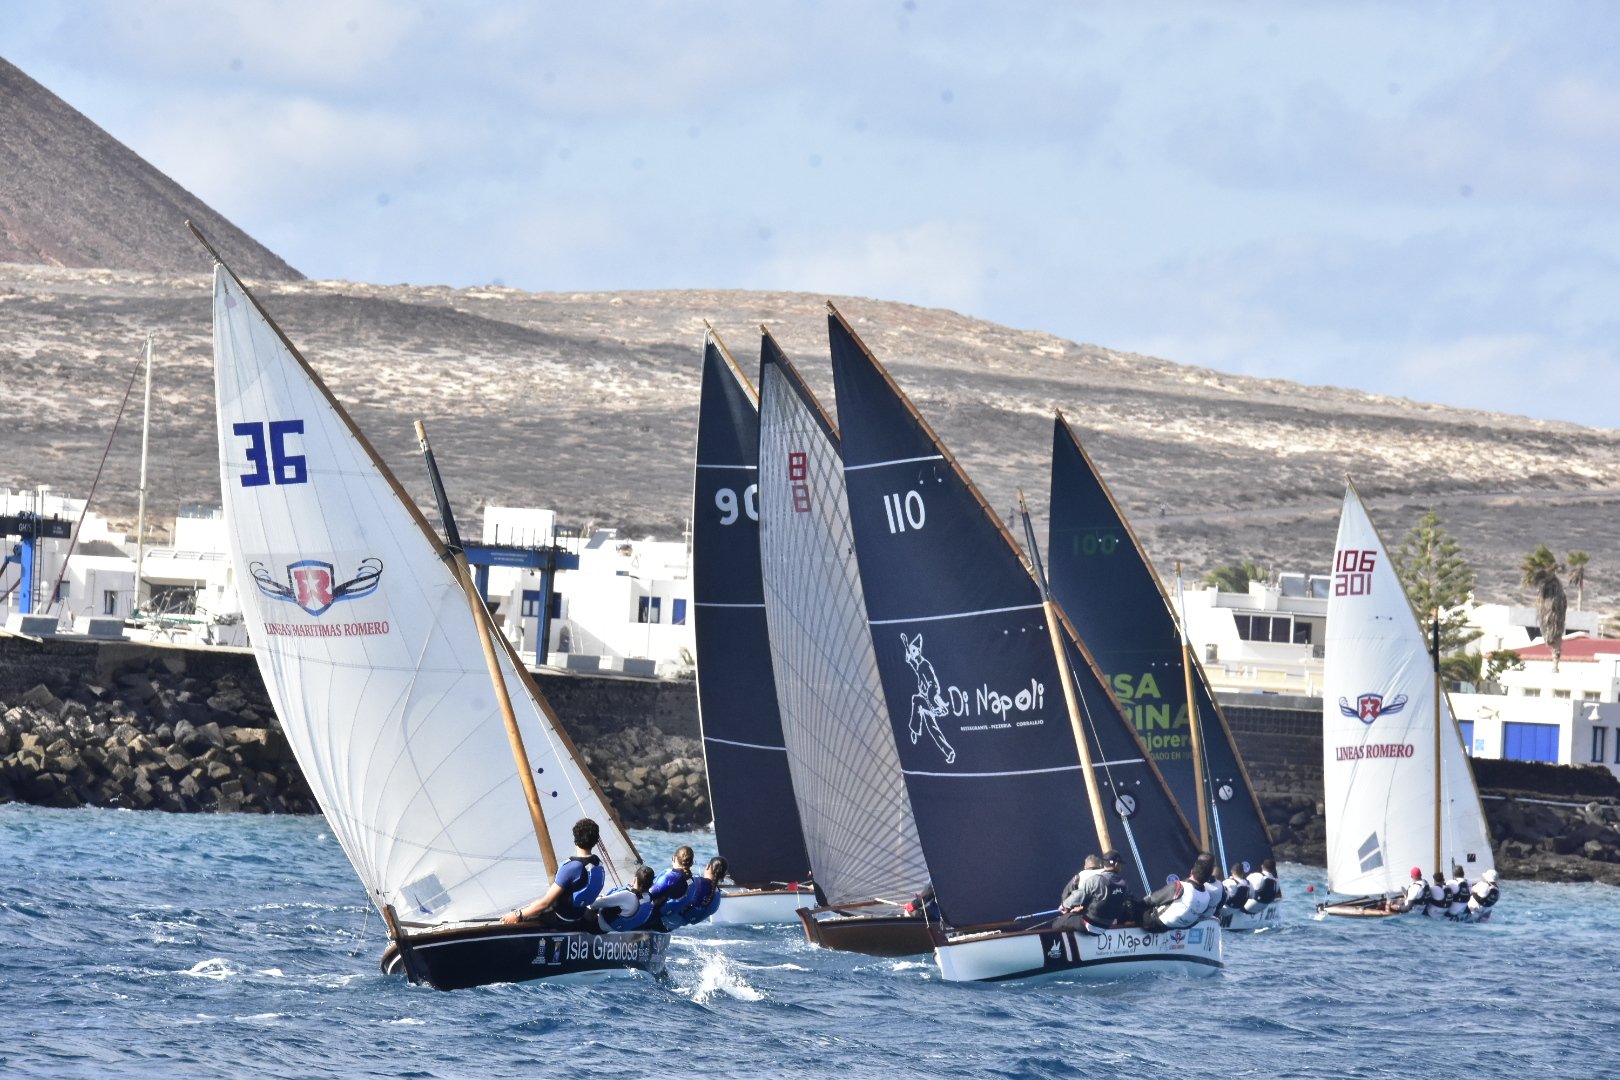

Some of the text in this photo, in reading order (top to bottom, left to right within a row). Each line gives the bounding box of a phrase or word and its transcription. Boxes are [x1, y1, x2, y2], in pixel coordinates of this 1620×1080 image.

[233, 420, 308, 487] 36
[883, 490, 926, 534] 110
[1073, 533, 1116, 556] 100
[1336, 550, 1377, 573] 106
[264, 621, 390, 637] LINEAS MARITIMAS ROMERO
[948, 678, 1045, 722] Di Napoli
[1140, 733, 1193, 753] jorer
[1336, 744, 1414, 761] LINEAS ROMERO
[566, 935, 638, 960] Isla Graciosa
[1117, 930, 1159, 951] Napoli
